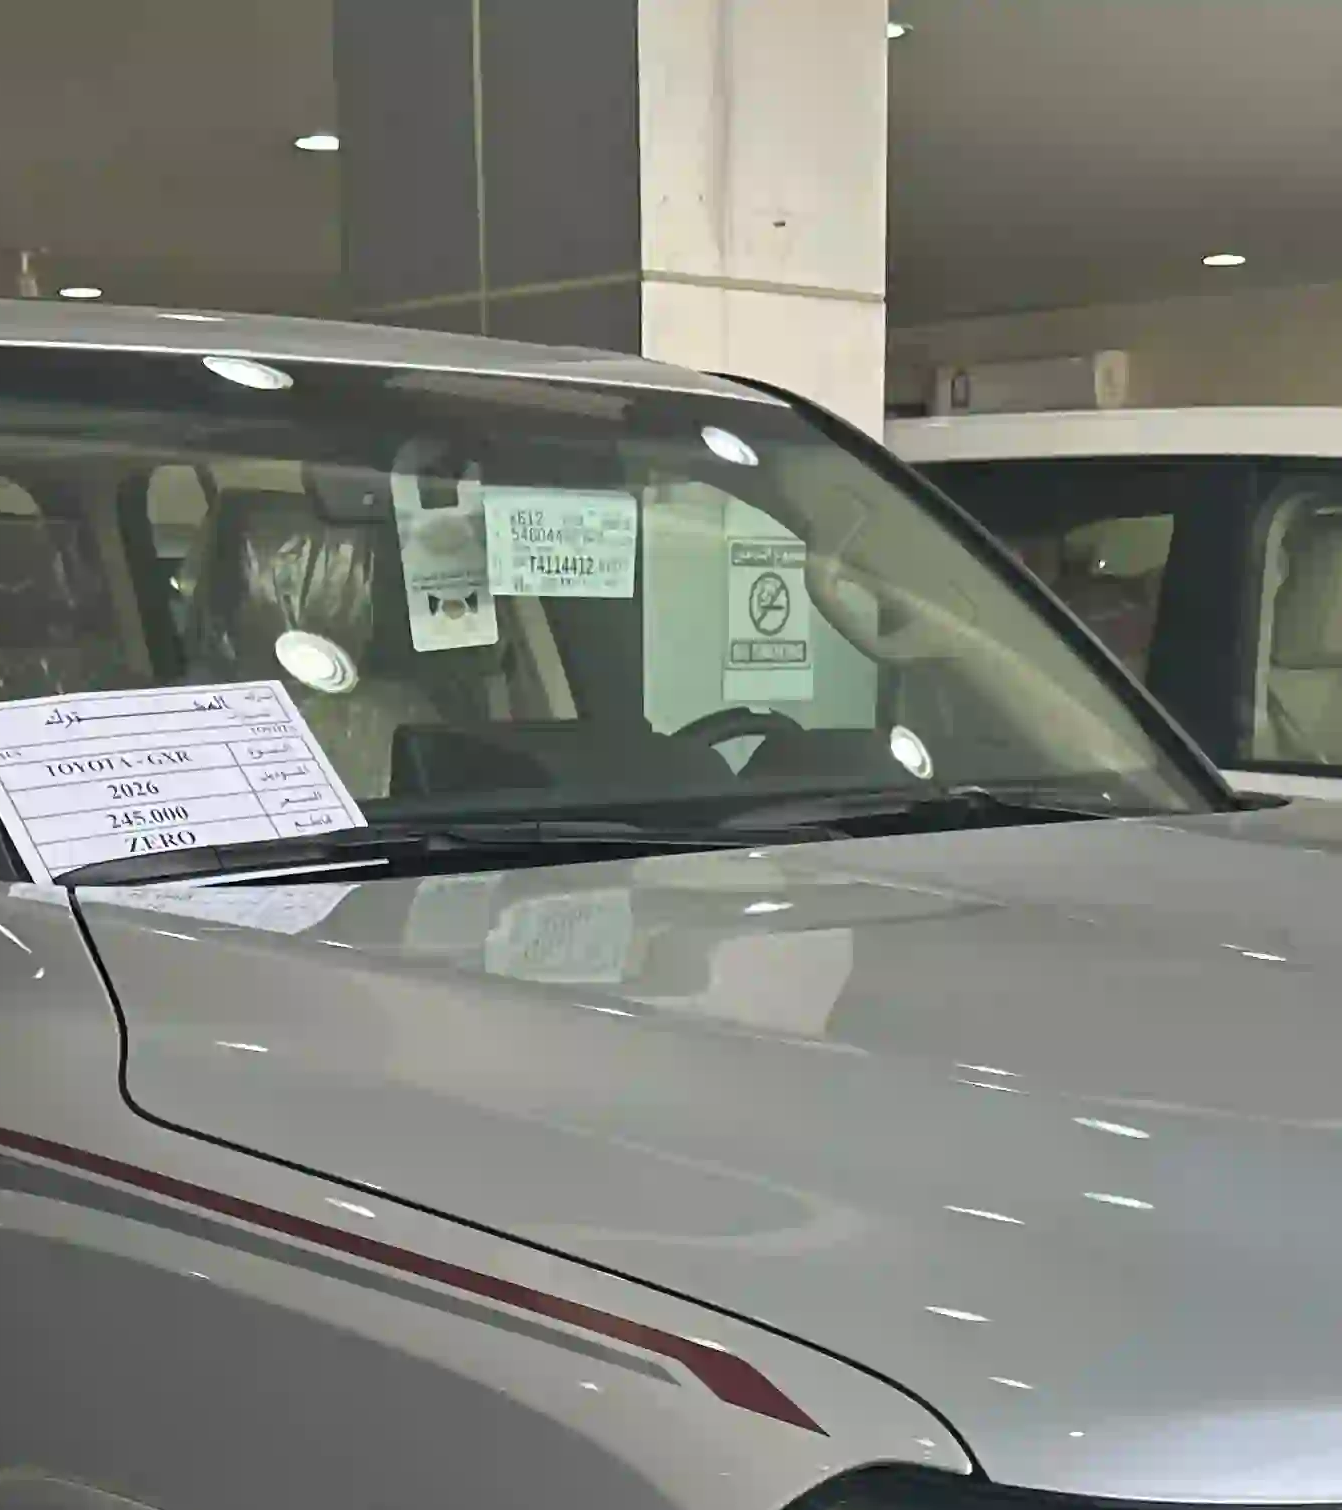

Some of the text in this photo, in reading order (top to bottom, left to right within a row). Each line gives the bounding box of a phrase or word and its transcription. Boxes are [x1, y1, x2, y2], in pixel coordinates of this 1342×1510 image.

[46, 756, 133, 777] TOYOTA
[147, 749, 192, 766] GXR
[107, 780, 160, 800] 2026
[107, 805, 190, 829] 245.000
[128, 829, 197, 853] ZERO
